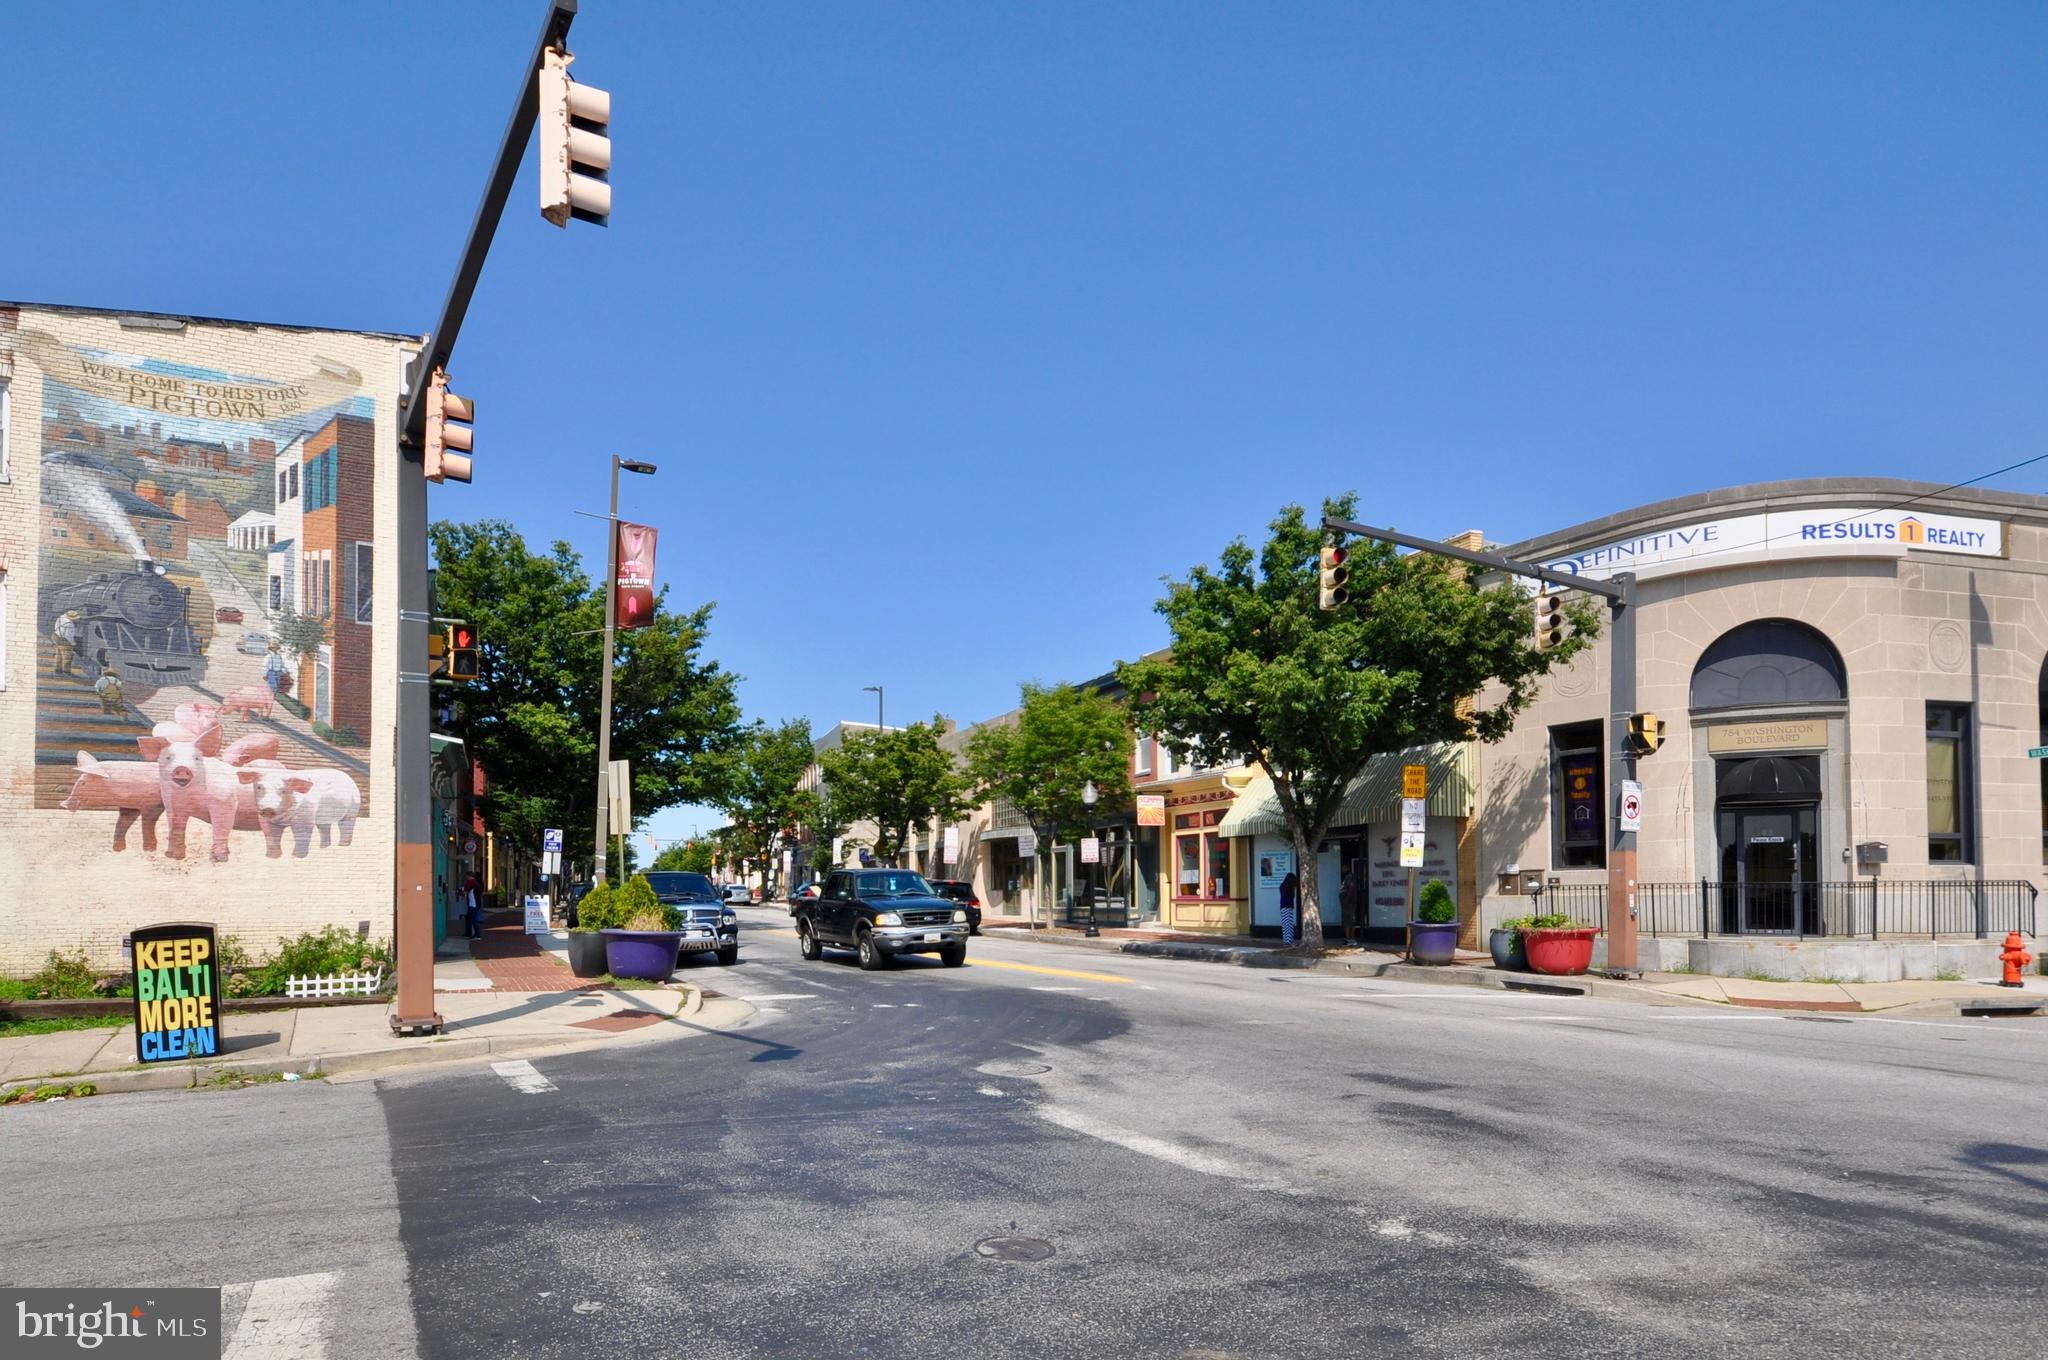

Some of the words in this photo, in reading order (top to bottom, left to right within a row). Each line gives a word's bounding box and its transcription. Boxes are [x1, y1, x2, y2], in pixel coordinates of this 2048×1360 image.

[81, 359, 185, 393] WELCOME
[192, 383, 218, 397] TO
[222, 384, 309, 401] HISTORIC
[128, 385, 266, 419] PIGTOWN
[1802, 523, 1896, 540] RESULTS
[1907, 525, 1914, 541] 1
[1927, 527, 1985, 548] REALTY
[617, 578, 650, 586] PIGTOWN
[1737, 734, 1800, 745] BOULEVARD
[1743, 724, 1814, 736] WASHINGTON
[135, 937, 210, 970] KEEP
[137, 964, 211, 1002] BALTI
[139, 996, 214, 1033] MORE
[141, 1026, 215, 1060] CLEAN
